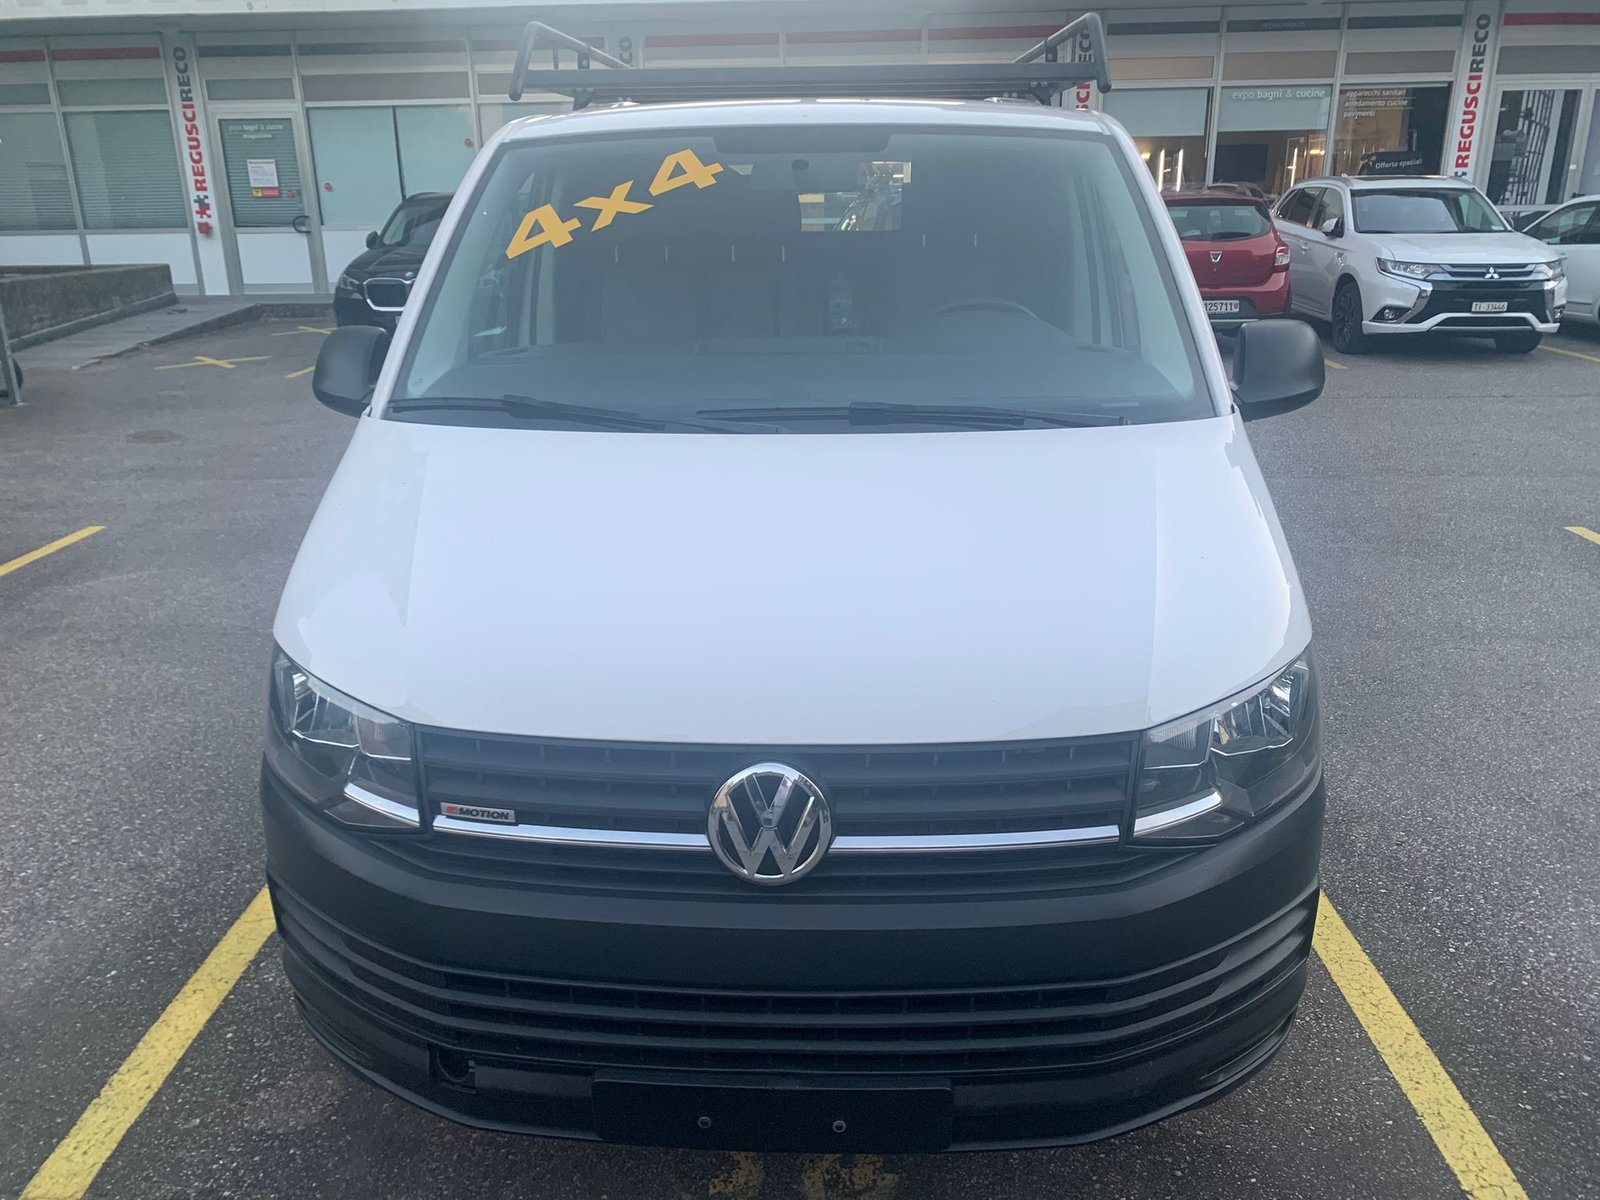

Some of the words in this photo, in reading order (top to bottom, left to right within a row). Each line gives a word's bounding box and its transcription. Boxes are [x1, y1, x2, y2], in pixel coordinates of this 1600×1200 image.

[1232, 91, 1254, 101] expo
[1257, 89, 1282, 101] bagni
[1286, 89, 1292, 98] &
[1296, 88, 1326, 98] cucine
[1346, 89, 1381, 99] apparecchi
[1382, 88, 1406, 97] sanitari
[505, 148, 724, 260] 4x4
[1204, 302, 1233, 311] 125711
